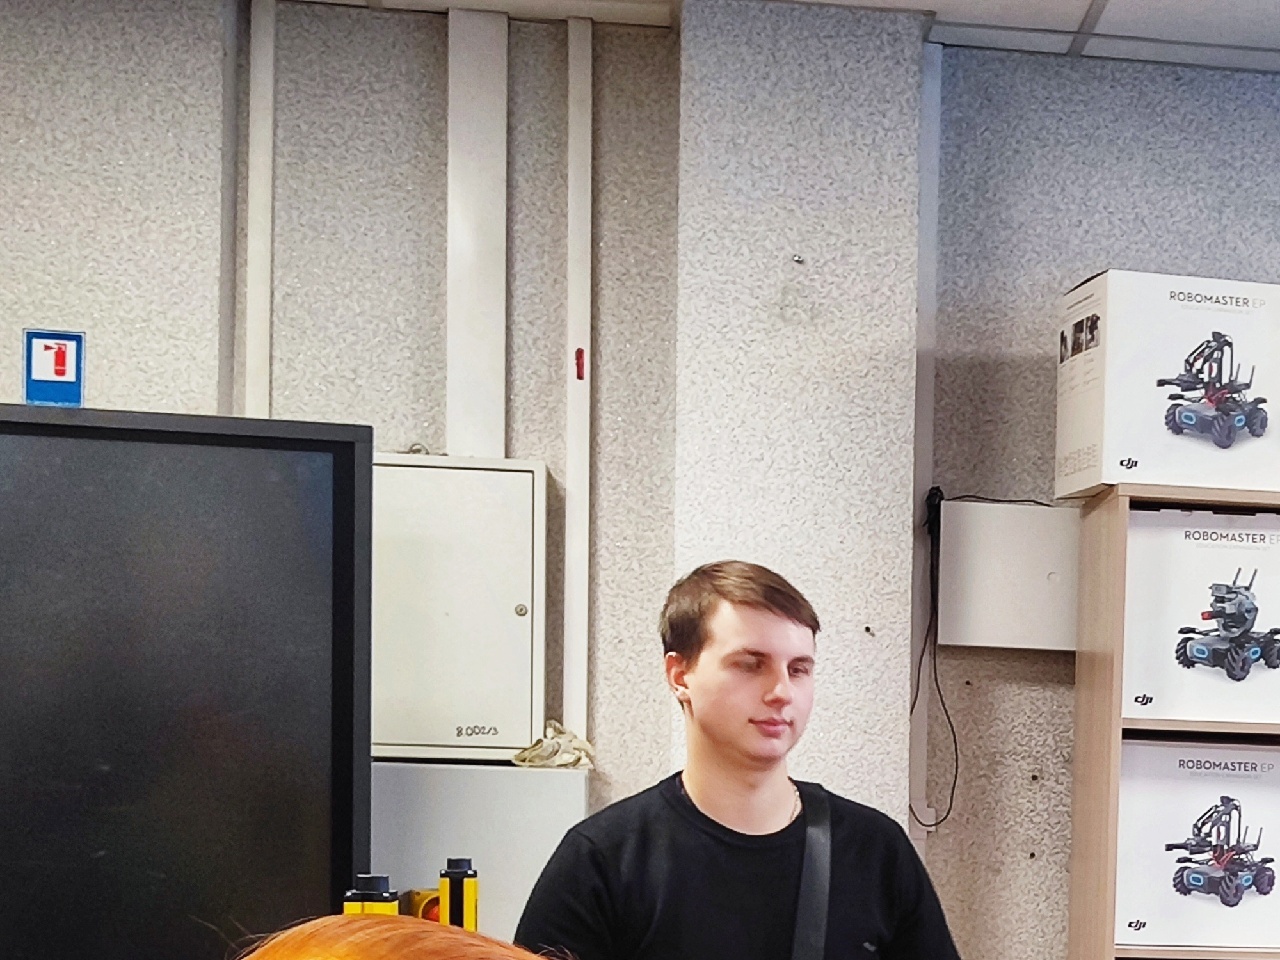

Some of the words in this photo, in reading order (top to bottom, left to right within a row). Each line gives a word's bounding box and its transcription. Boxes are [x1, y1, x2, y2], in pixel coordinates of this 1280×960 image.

[1169, 291, 1250, 308] ROBOMASTER
[1184, 530, 1267, 544] ROBOMASTER
[1178, 759, 1258, 772] ROBOMASTER
[1260, 763, 1275, 773] EP
